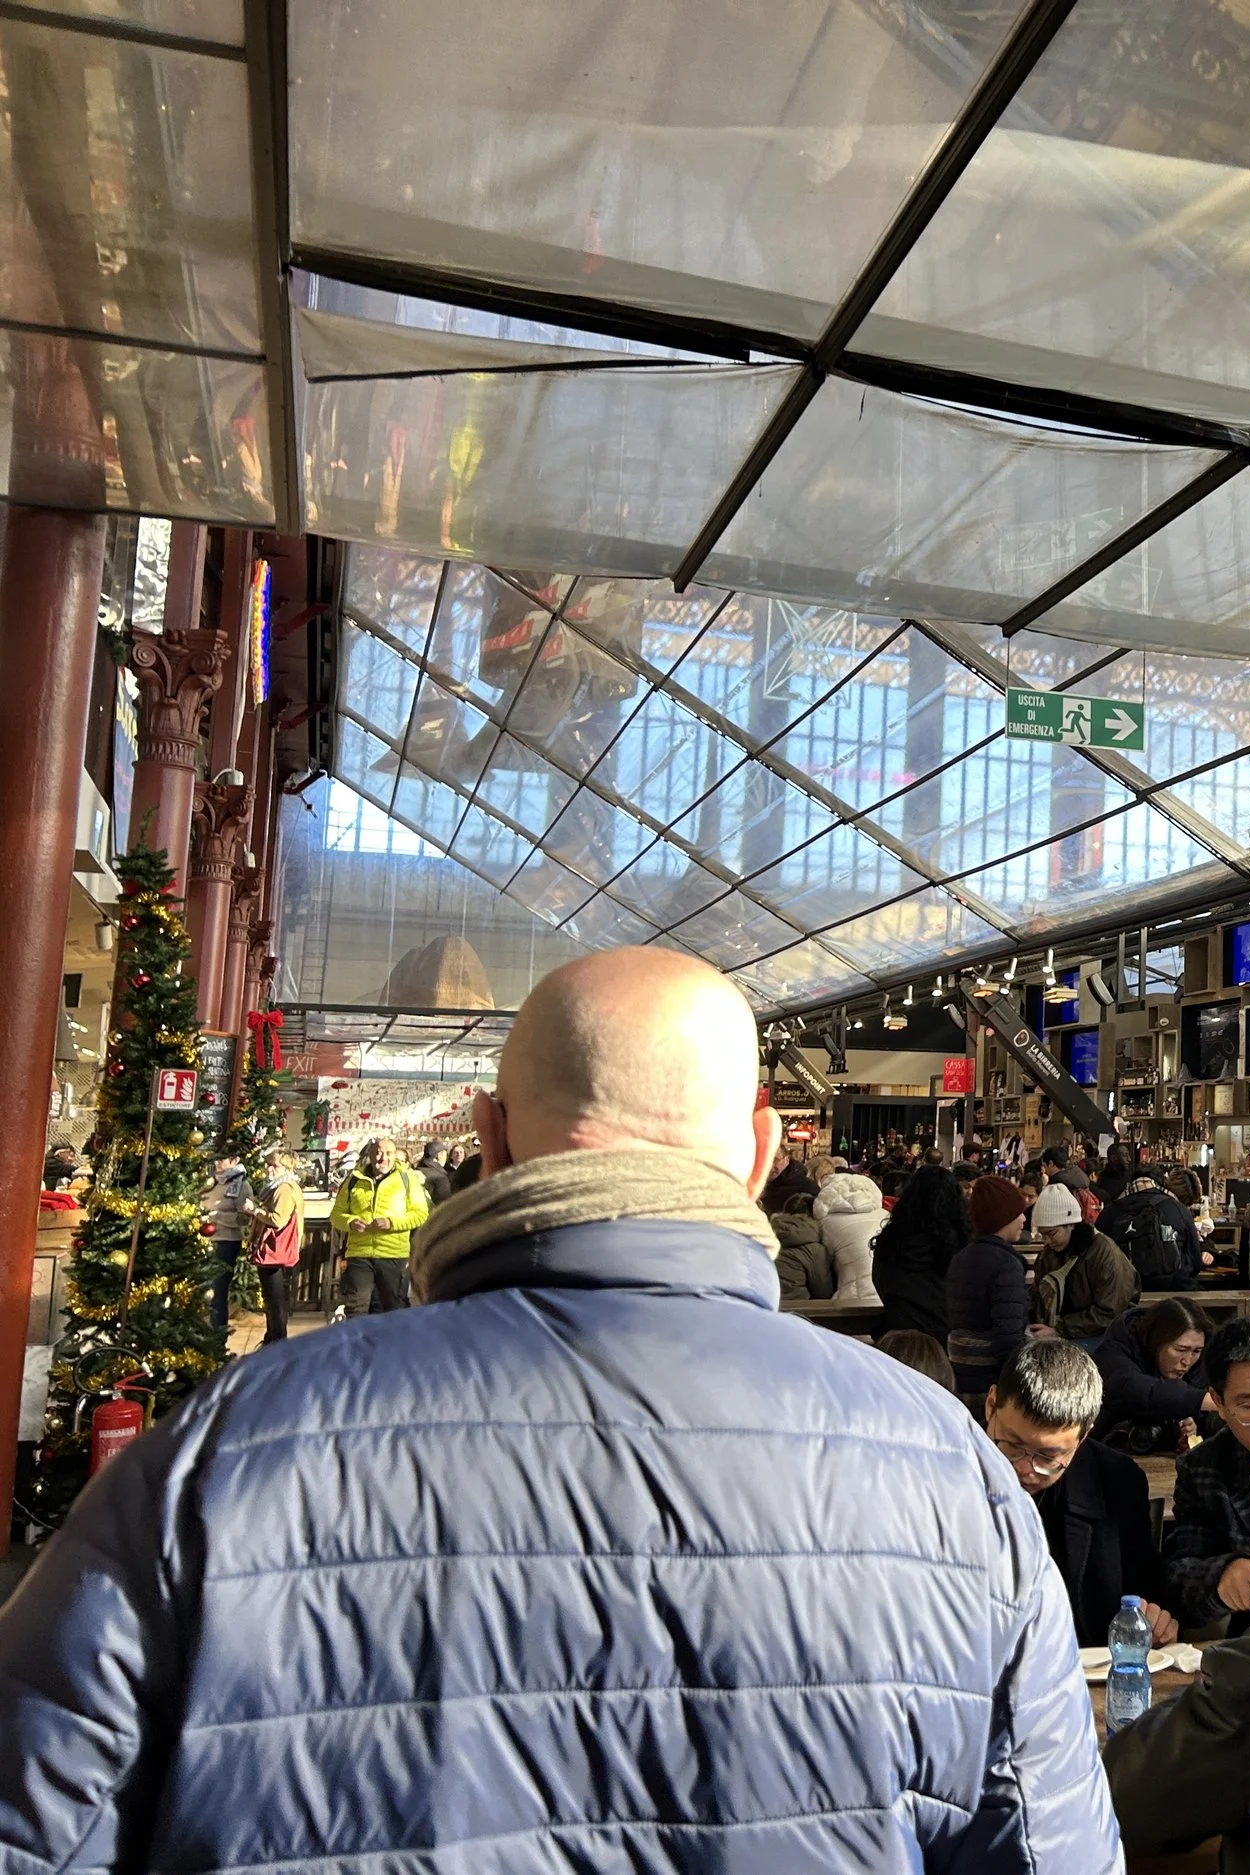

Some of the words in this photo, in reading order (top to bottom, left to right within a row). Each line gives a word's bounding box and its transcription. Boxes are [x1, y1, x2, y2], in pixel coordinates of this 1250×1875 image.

[1018, 694, 1046, 708] USCITA
[1028, 710, 1036, 721] DI
[1008, 722, 1055, 737] EMERGENZA
[286, 1056, 318, 1072] EXIT
[945, 1060, 966, 1070] CASSA
[1031, 1044, 1039, 1054] LA
[1037, 1052, 1061, 1080] BIRRERIA
[794, 1062, 826, 1094] INFOPOINT
